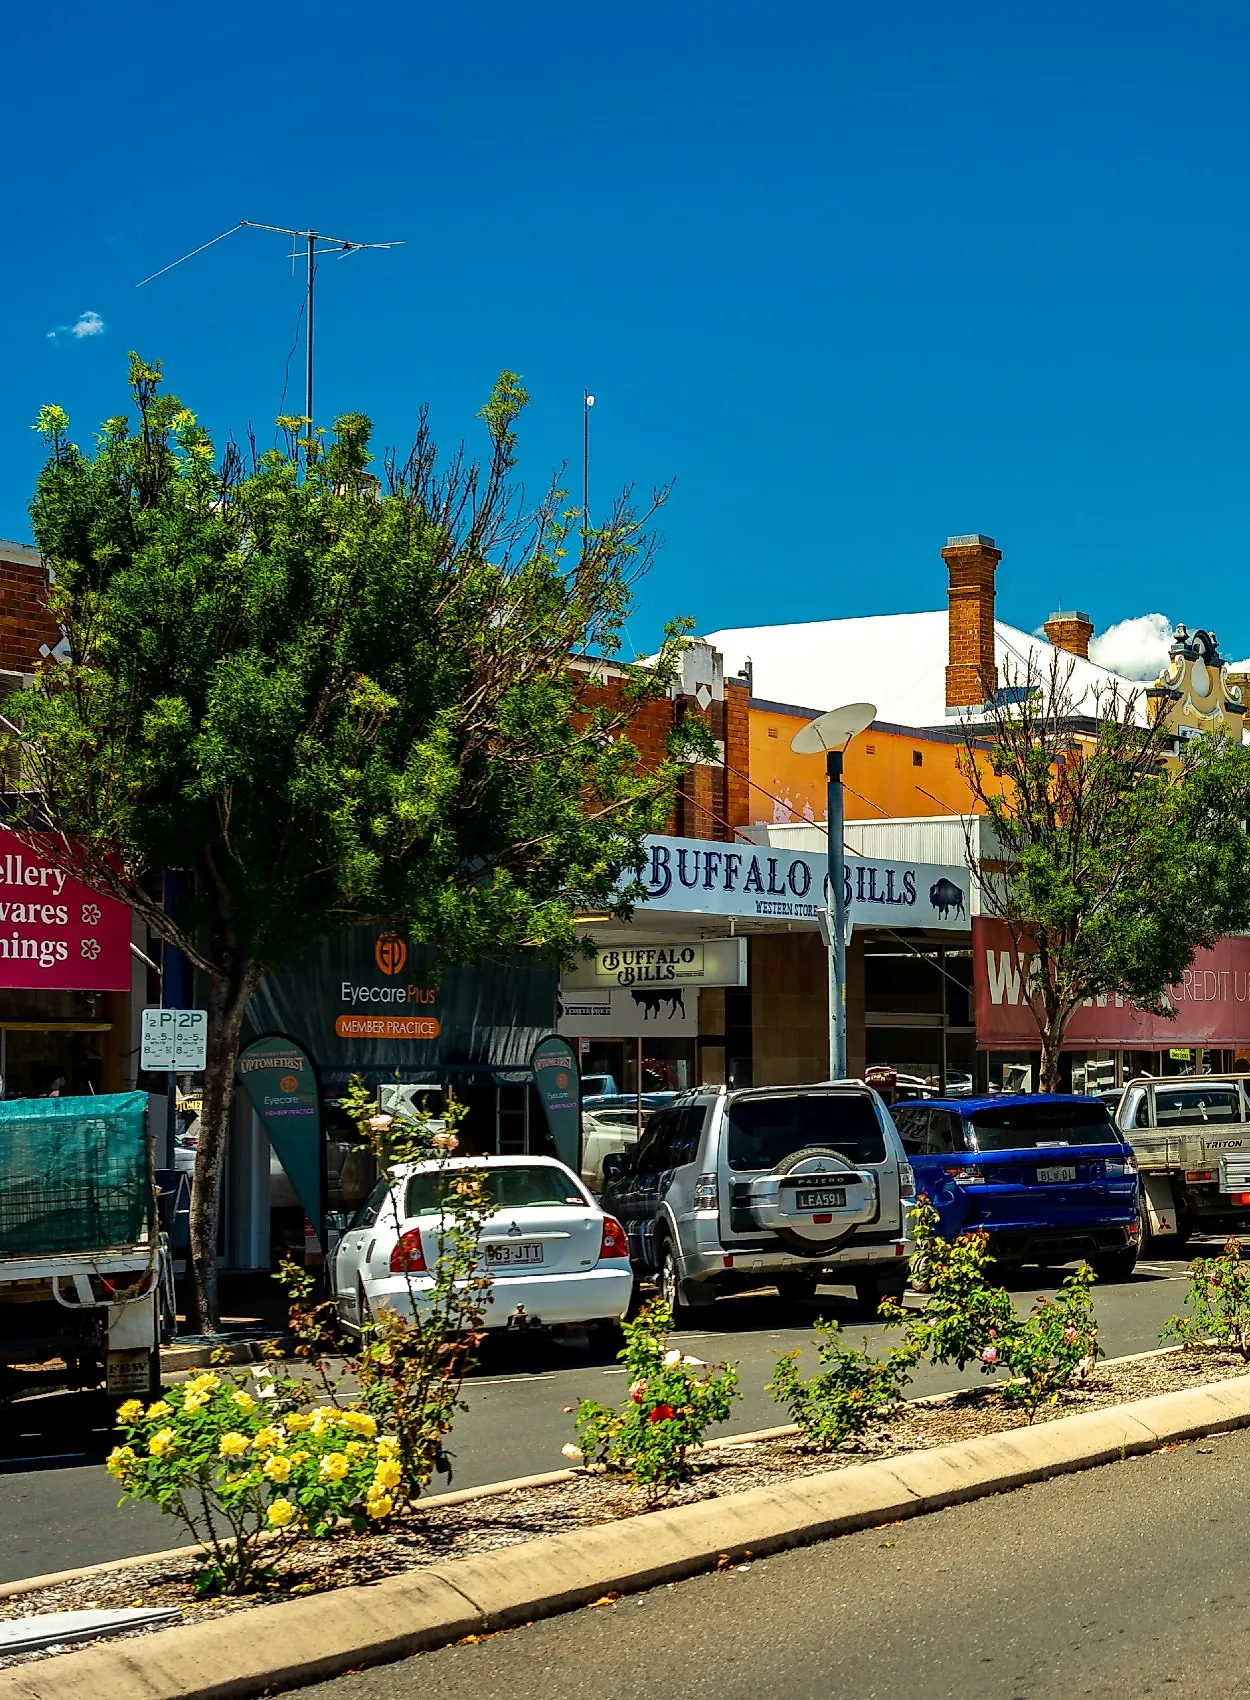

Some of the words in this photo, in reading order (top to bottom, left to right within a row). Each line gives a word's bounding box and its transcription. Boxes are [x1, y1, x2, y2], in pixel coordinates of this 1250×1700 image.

[755, 900, 793, 917] WESTERN
[602, 947, 696, 971] BUFFALO
[617, 965, 676, 986] BILLS
[1169, 969, 1229, 1002] CREDIT
[178, 1013, 203, 1028] 2P
[341, 1021, 385, 1034] MEMBER
[386, 1021, 435, 1035] PRACTICE
[240, 1057, 304, 1074] OPTOMETRIST
[1205, 1139, 1243, 1149] TRITON
[797, 1177, 845, 1185] PAJERO
[800, 1192, 841, 1208] LEA591
